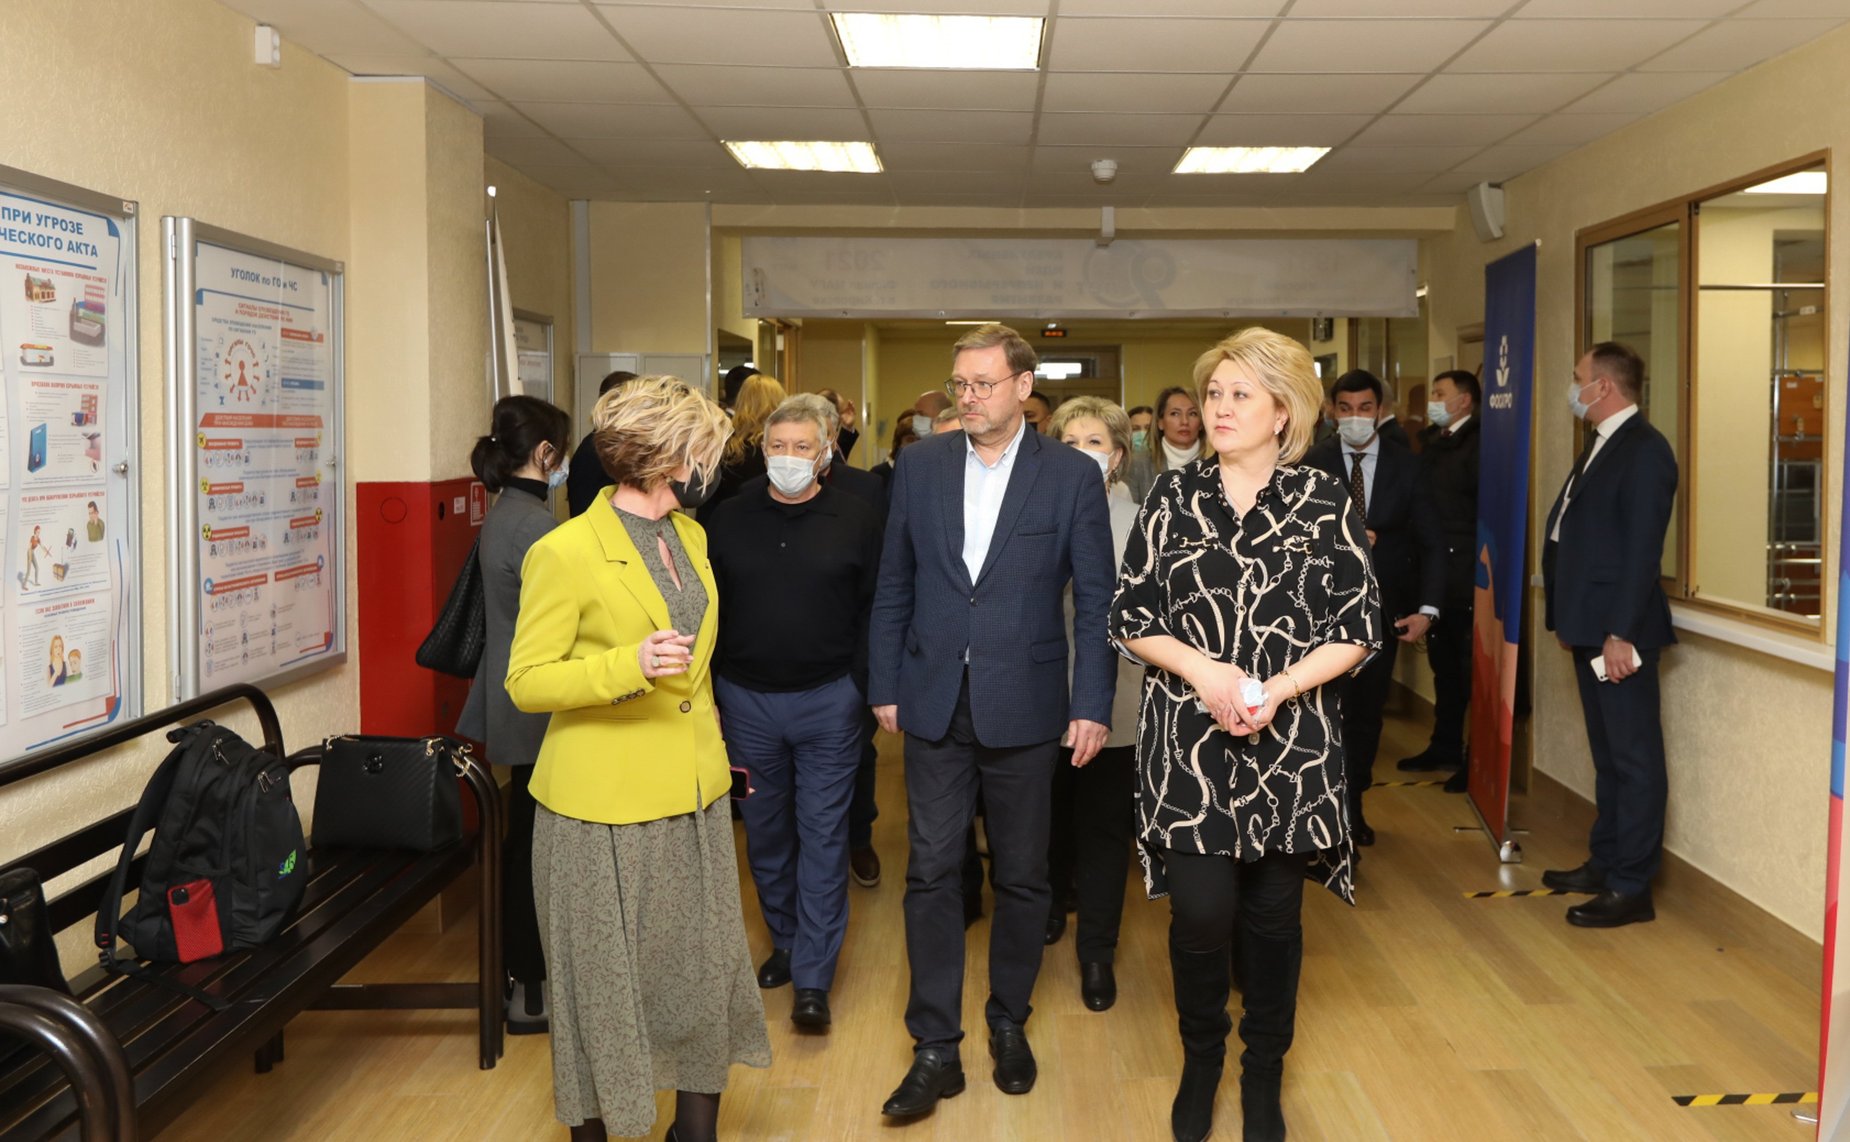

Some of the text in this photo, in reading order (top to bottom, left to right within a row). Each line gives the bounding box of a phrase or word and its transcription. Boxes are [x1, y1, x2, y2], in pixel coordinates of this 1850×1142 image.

[1, 207, 84, 235] ПРИ УГРОЗЕ
[67, 240, 98, 257] АКТА
[231, 267, 261, 283] УГОЛОК
[262, 276, 271, 286] по
[272, 276, 281, 287] ГО
[289, 281, 298, 291] ЧС
